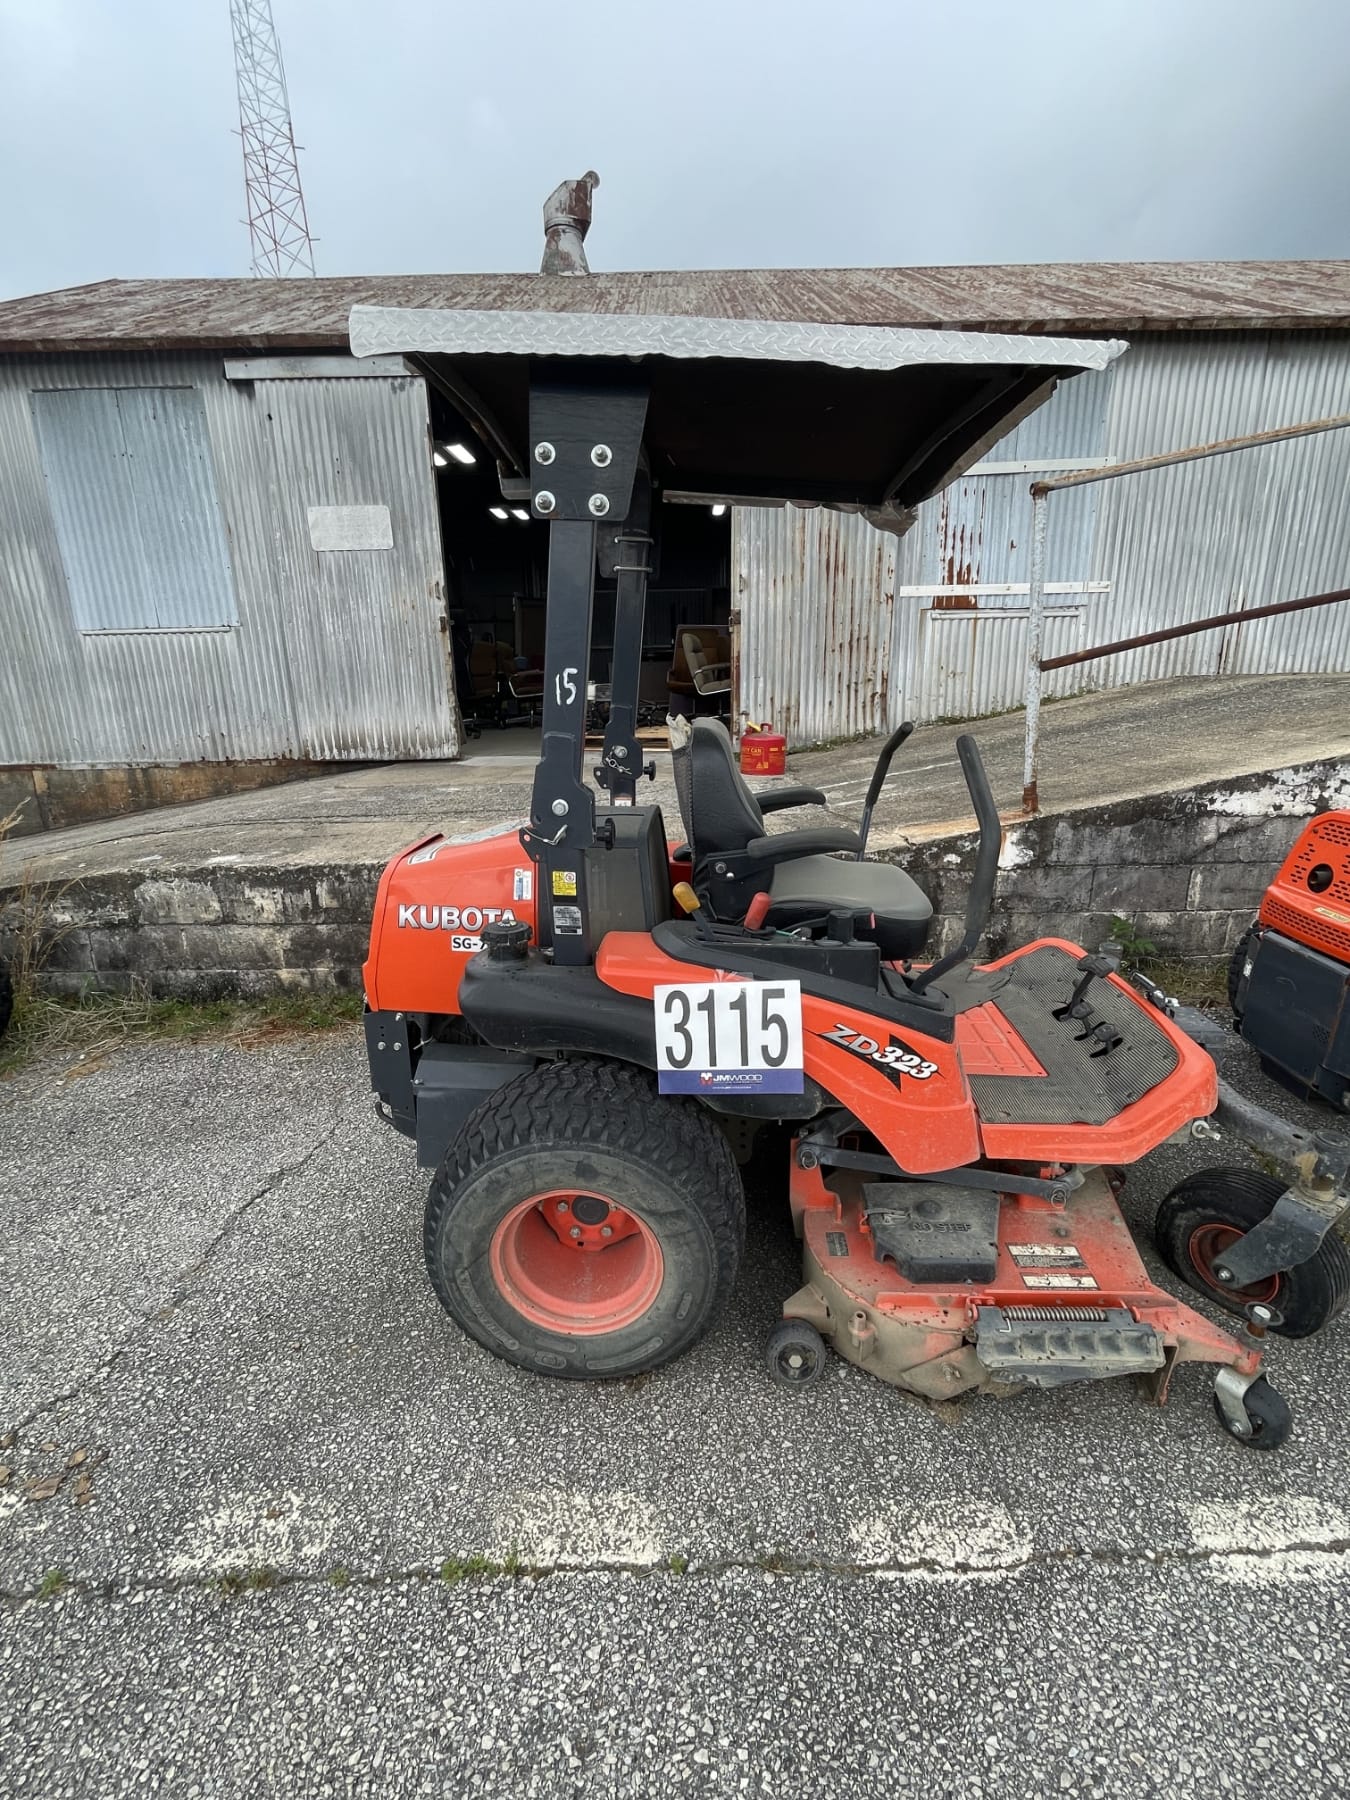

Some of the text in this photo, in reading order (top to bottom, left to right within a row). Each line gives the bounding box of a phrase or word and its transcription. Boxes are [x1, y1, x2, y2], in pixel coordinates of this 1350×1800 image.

[555, 667, 578, 706] 15
[397, 903, 517, 932] KUBOTA
[664, 987, 789, 1069] 3115
[820, 1022, 940, 1080] ZD323
[912, 1222, 933, 1233] NO
